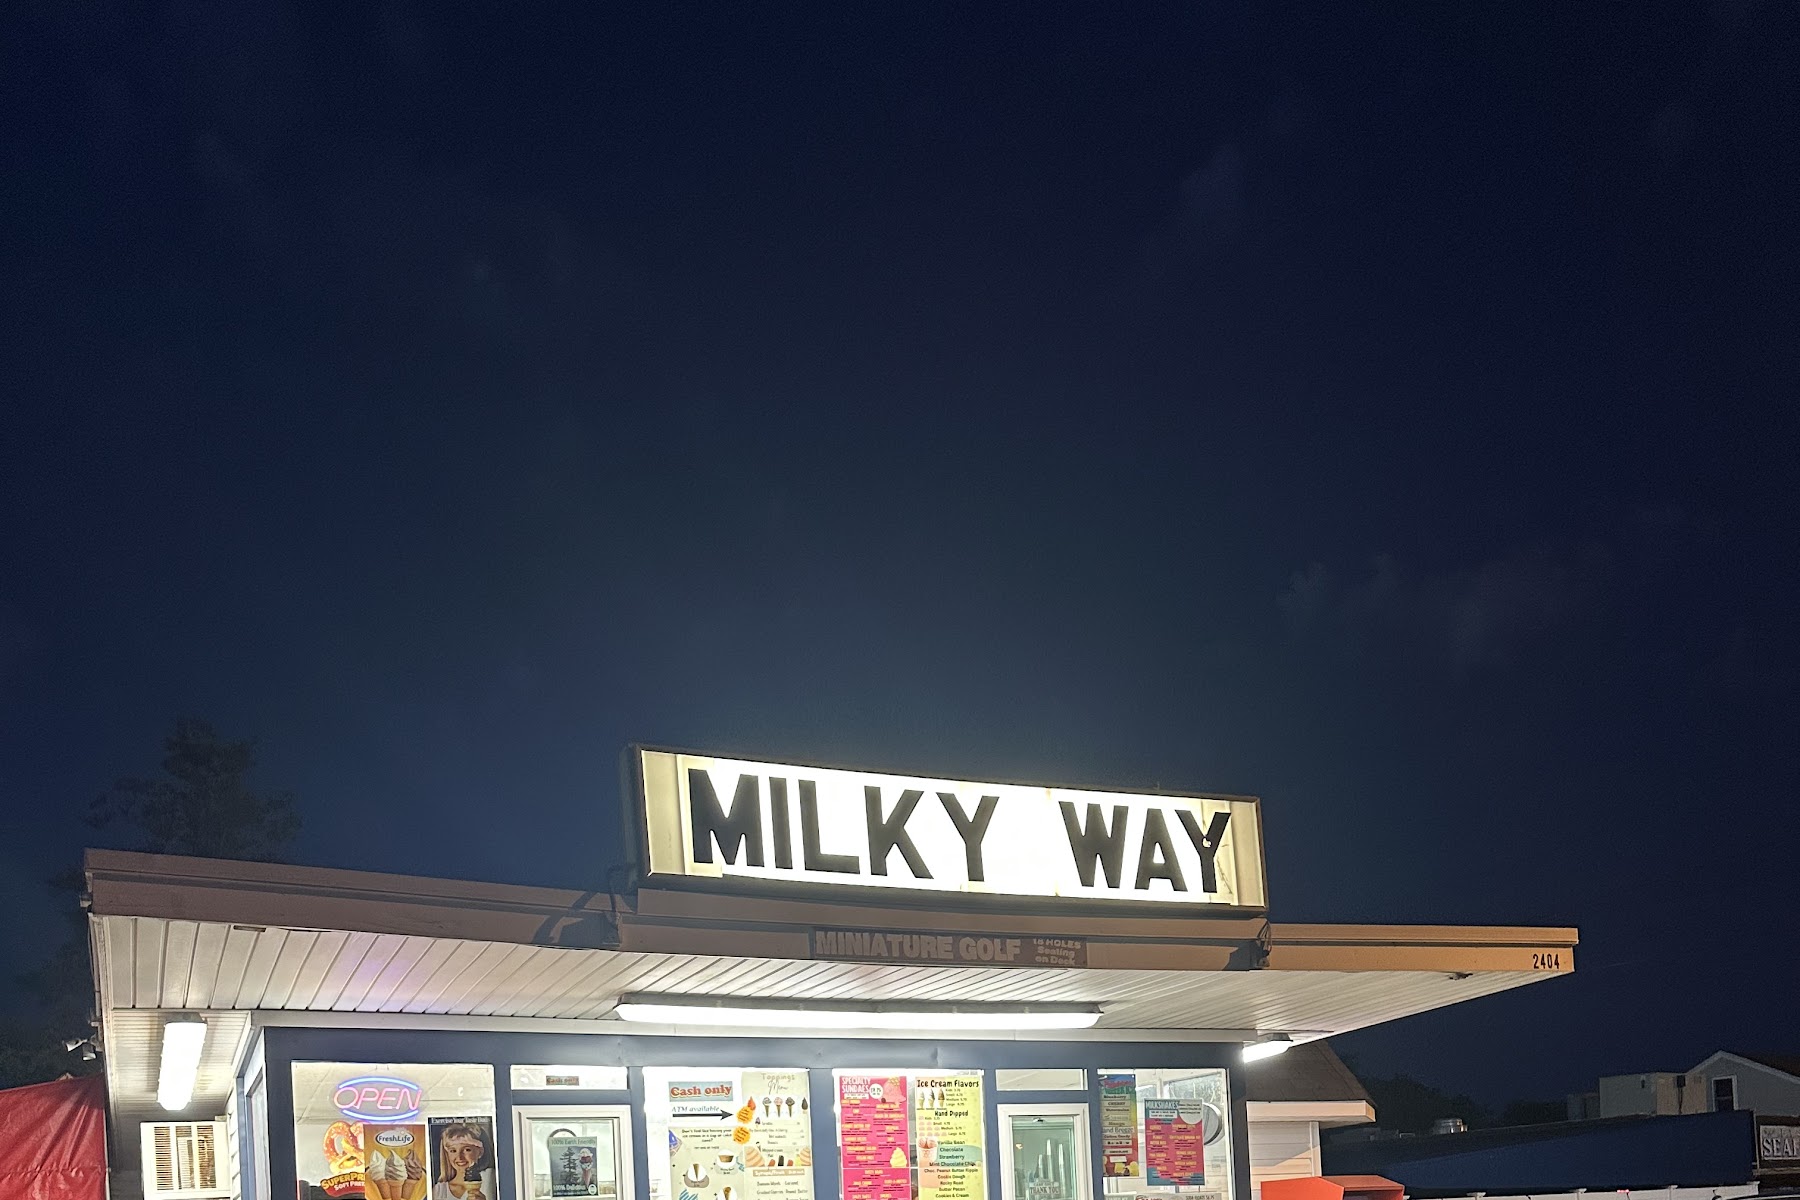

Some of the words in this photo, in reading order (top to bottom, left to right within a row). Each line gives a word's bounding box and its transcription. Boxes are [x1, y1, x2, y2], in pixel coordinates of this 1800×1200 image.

[688, 768, 999, 882] MILKY
[1058, 801, 1231, 893] WAY
[815, 930, 954, 960] MINIATURE
[958, 937, 1022, 961] GOLF
[1048, 939, 1081, 949] HOLES
[1037, 946, 1075, 959] Seating
[1035, 955, 1048, 964] on
[1050, 954, 1076, 966] Deck
[1532, 953, 1560, 969] 2404
[761, 1072, 796, 1081] Toppings
[842, 1084, 869, 1093] SUNDAES
[916, 1080, 928, 1088] Ice
[930, 1079, 952, 1088] Cream
[954, 1079, 979, 1088] Flavors
[670, 1086, 702, 1096] Cash
[704, 1085, 732, 1097] only
[334, 1087, 422, 1111] OPEN
[1146, 1101, 1179, 1109] MILKSHAKES
[950, 1110, 968, 1118] Dipped
[334, 1182, 350, 1192] SOFT
